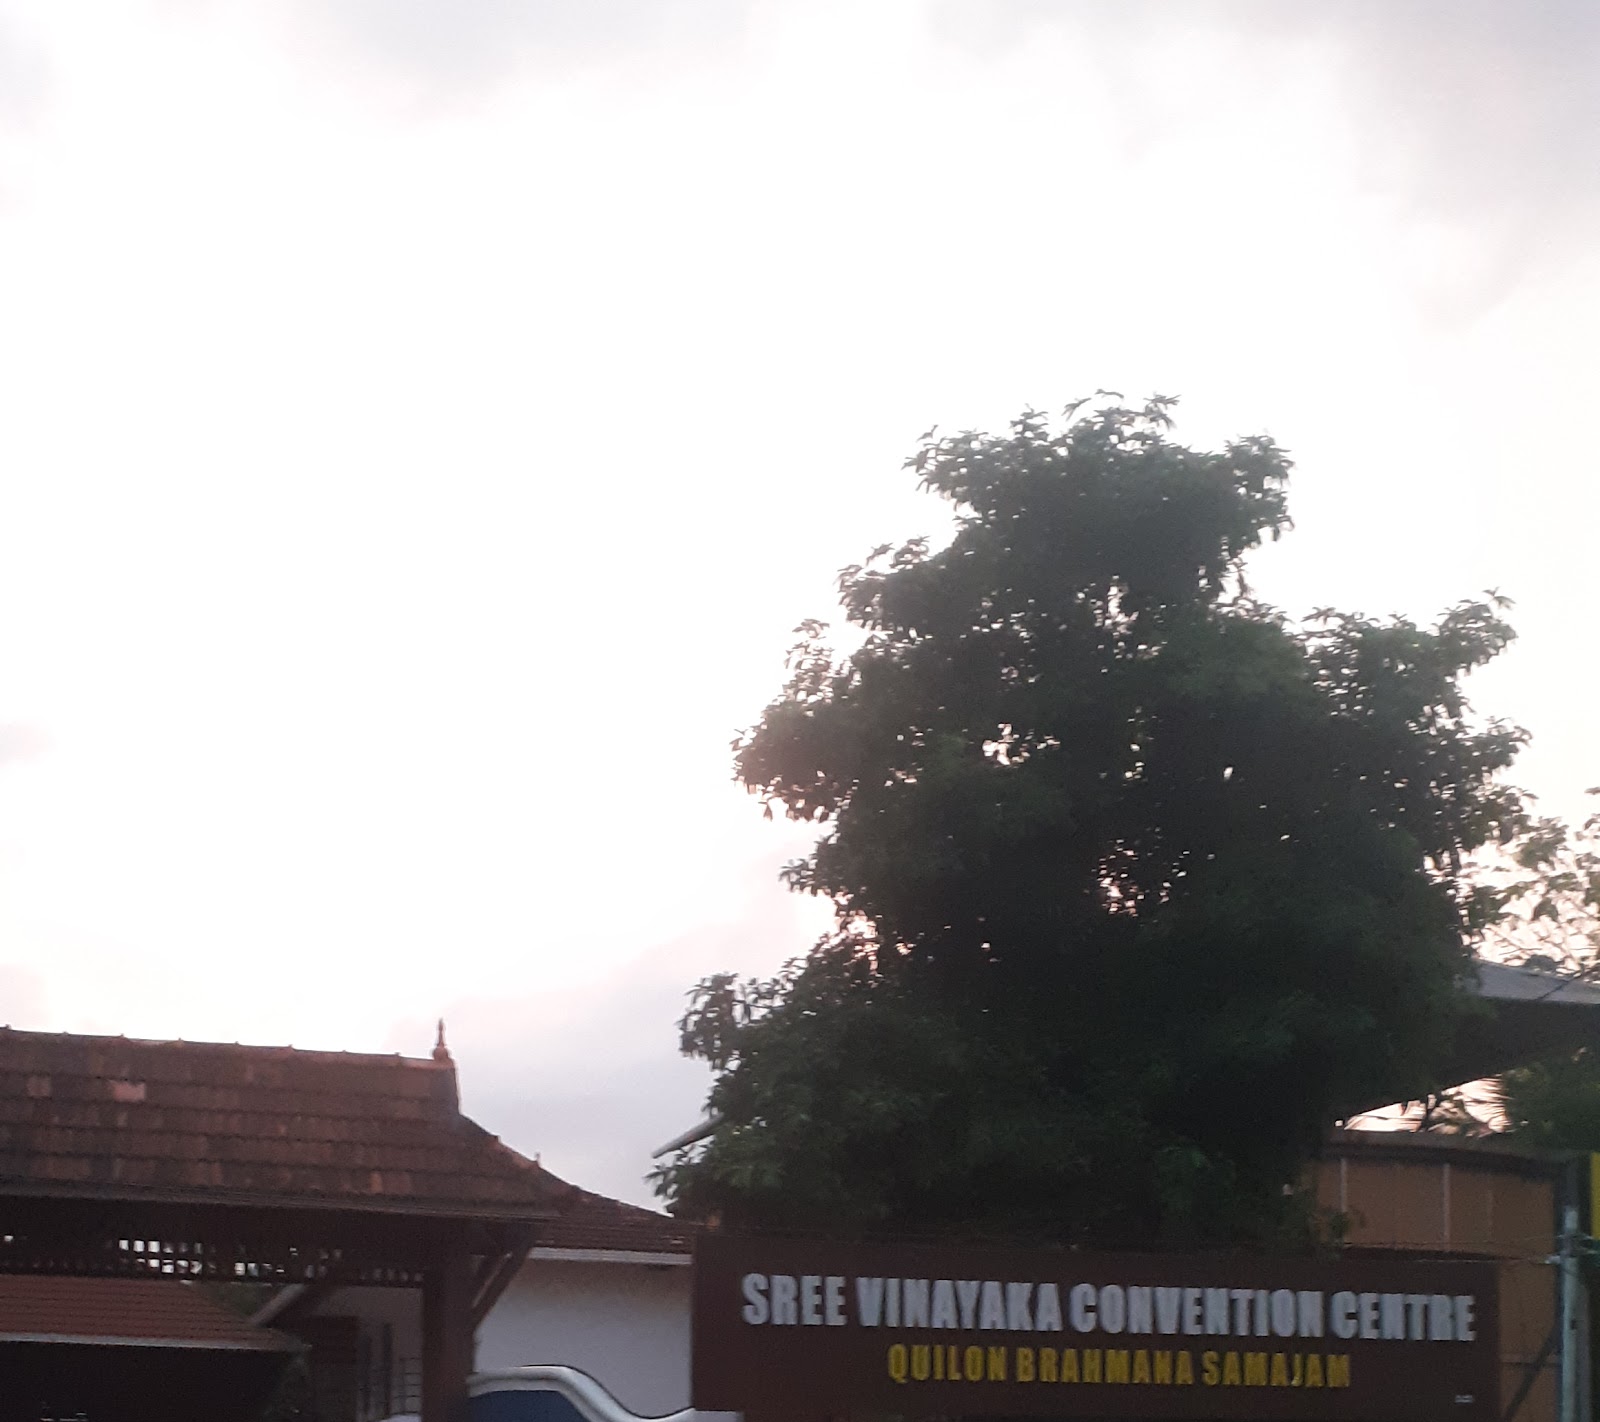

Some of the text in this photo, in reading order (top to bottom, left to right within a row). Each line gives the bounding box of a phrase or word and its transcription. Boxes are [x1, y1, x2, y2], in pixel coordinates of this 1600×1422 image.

[741, 1273, 1477, 1341] SREE VINAYAKA CONVENTION CENTRE
[887, 1343, 1351, 1388] QUILON BRAHMANA SAMAJAM
